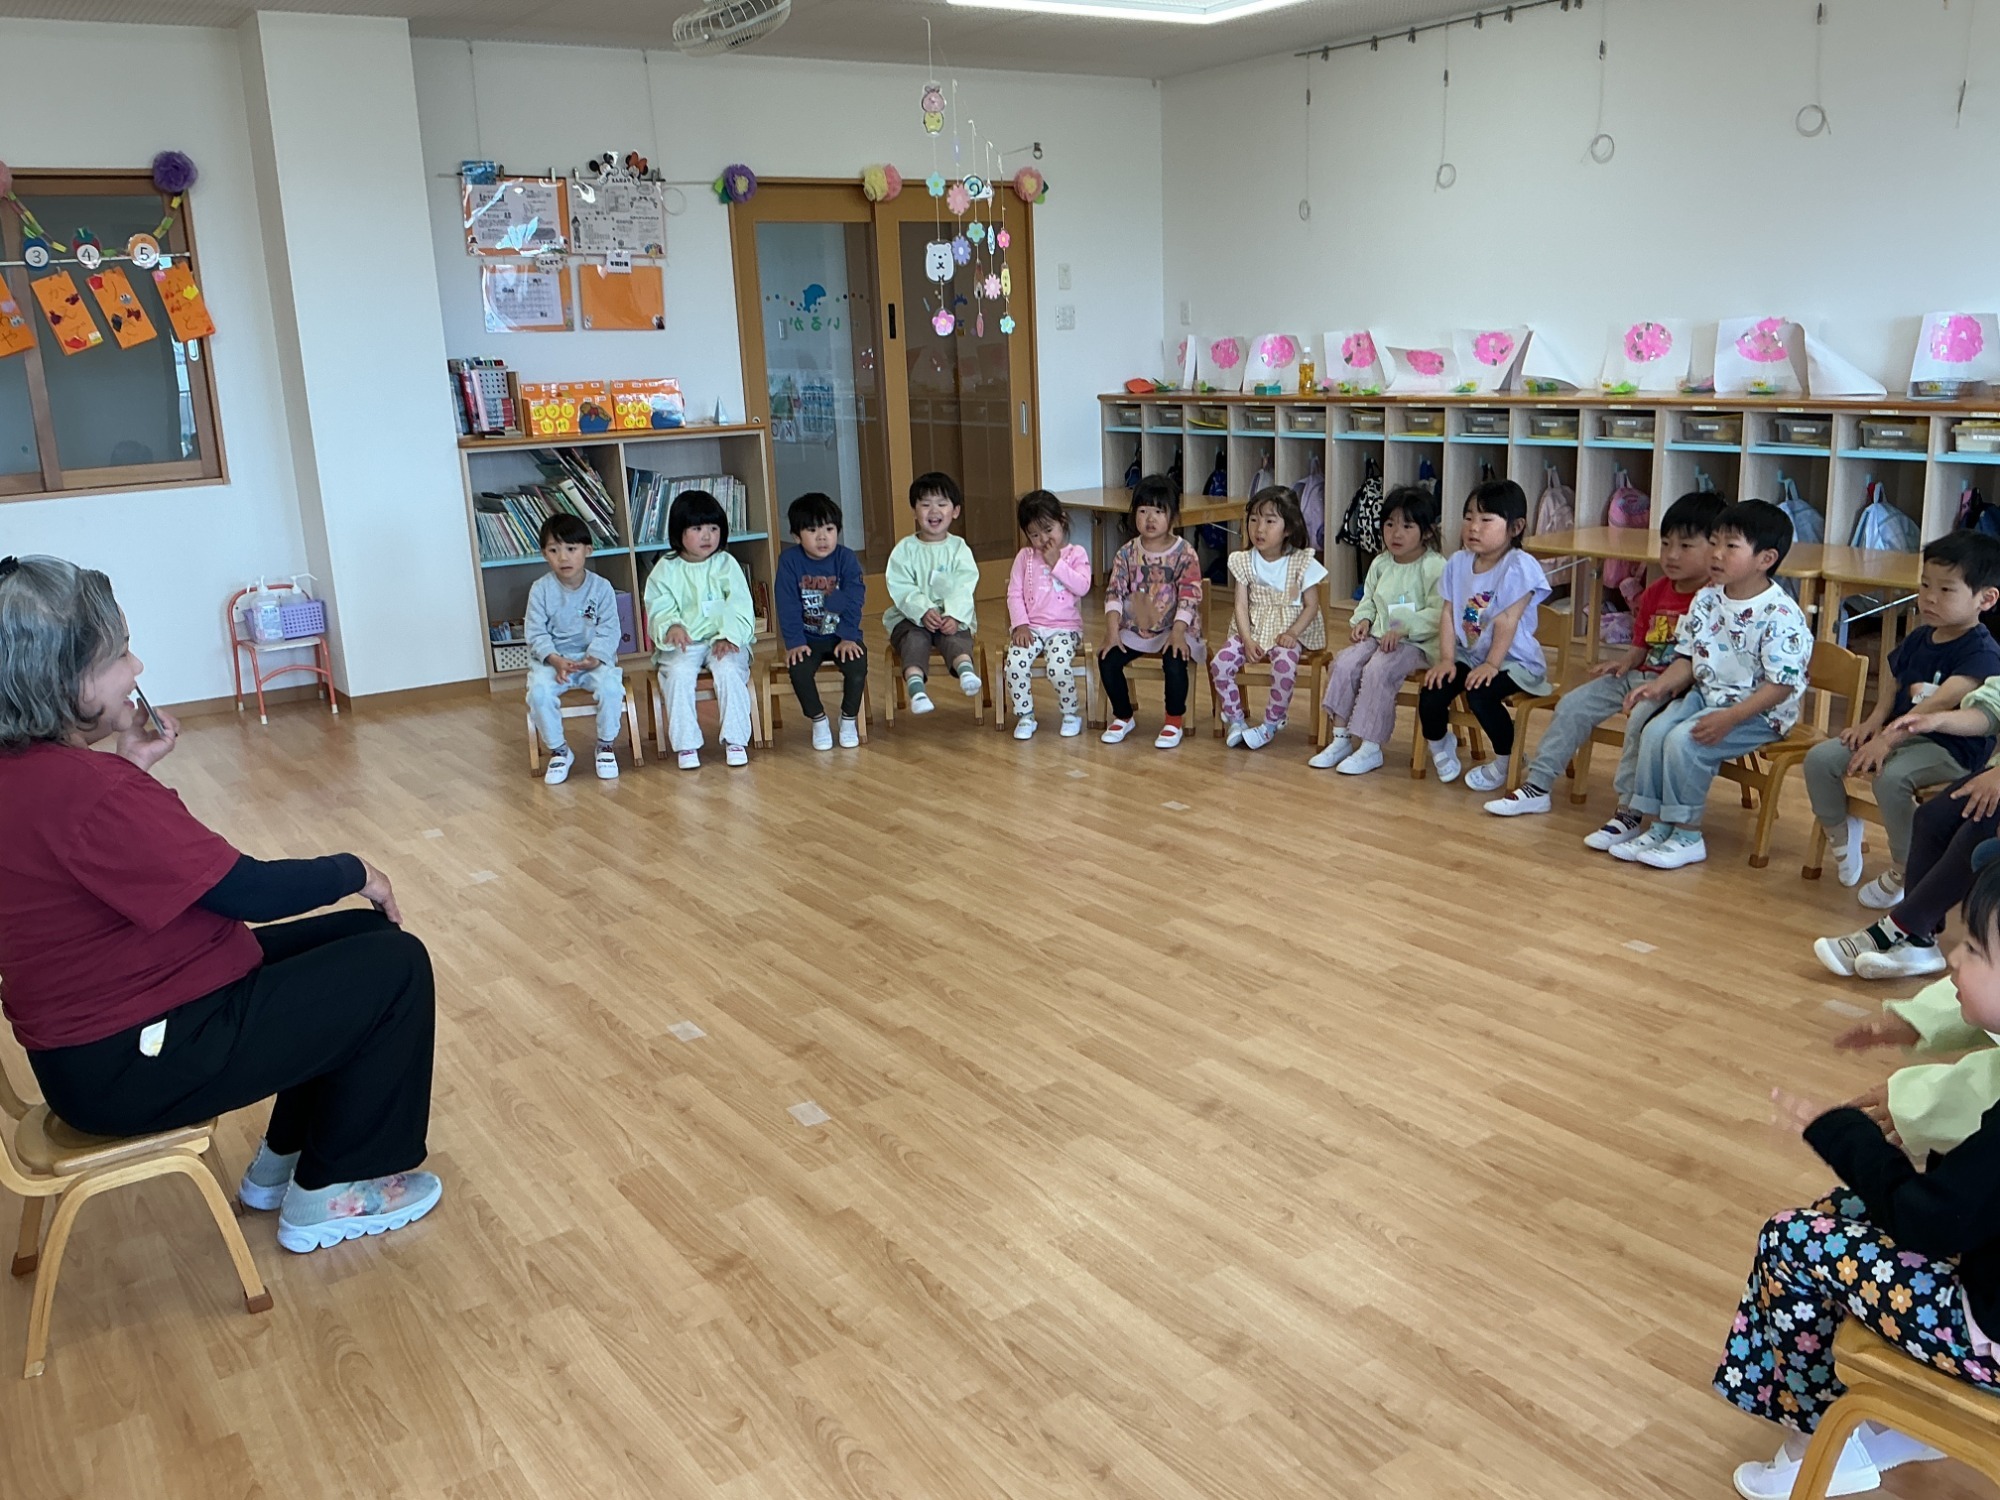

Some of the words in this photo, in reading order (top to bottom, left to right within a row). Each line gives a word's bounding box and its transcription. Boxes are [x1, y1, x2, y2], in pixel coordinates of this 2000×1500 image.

[32, 250, 42, 264] 3
[82, 248, 92, 262] 4
[140, 247, 150, 261] 5
